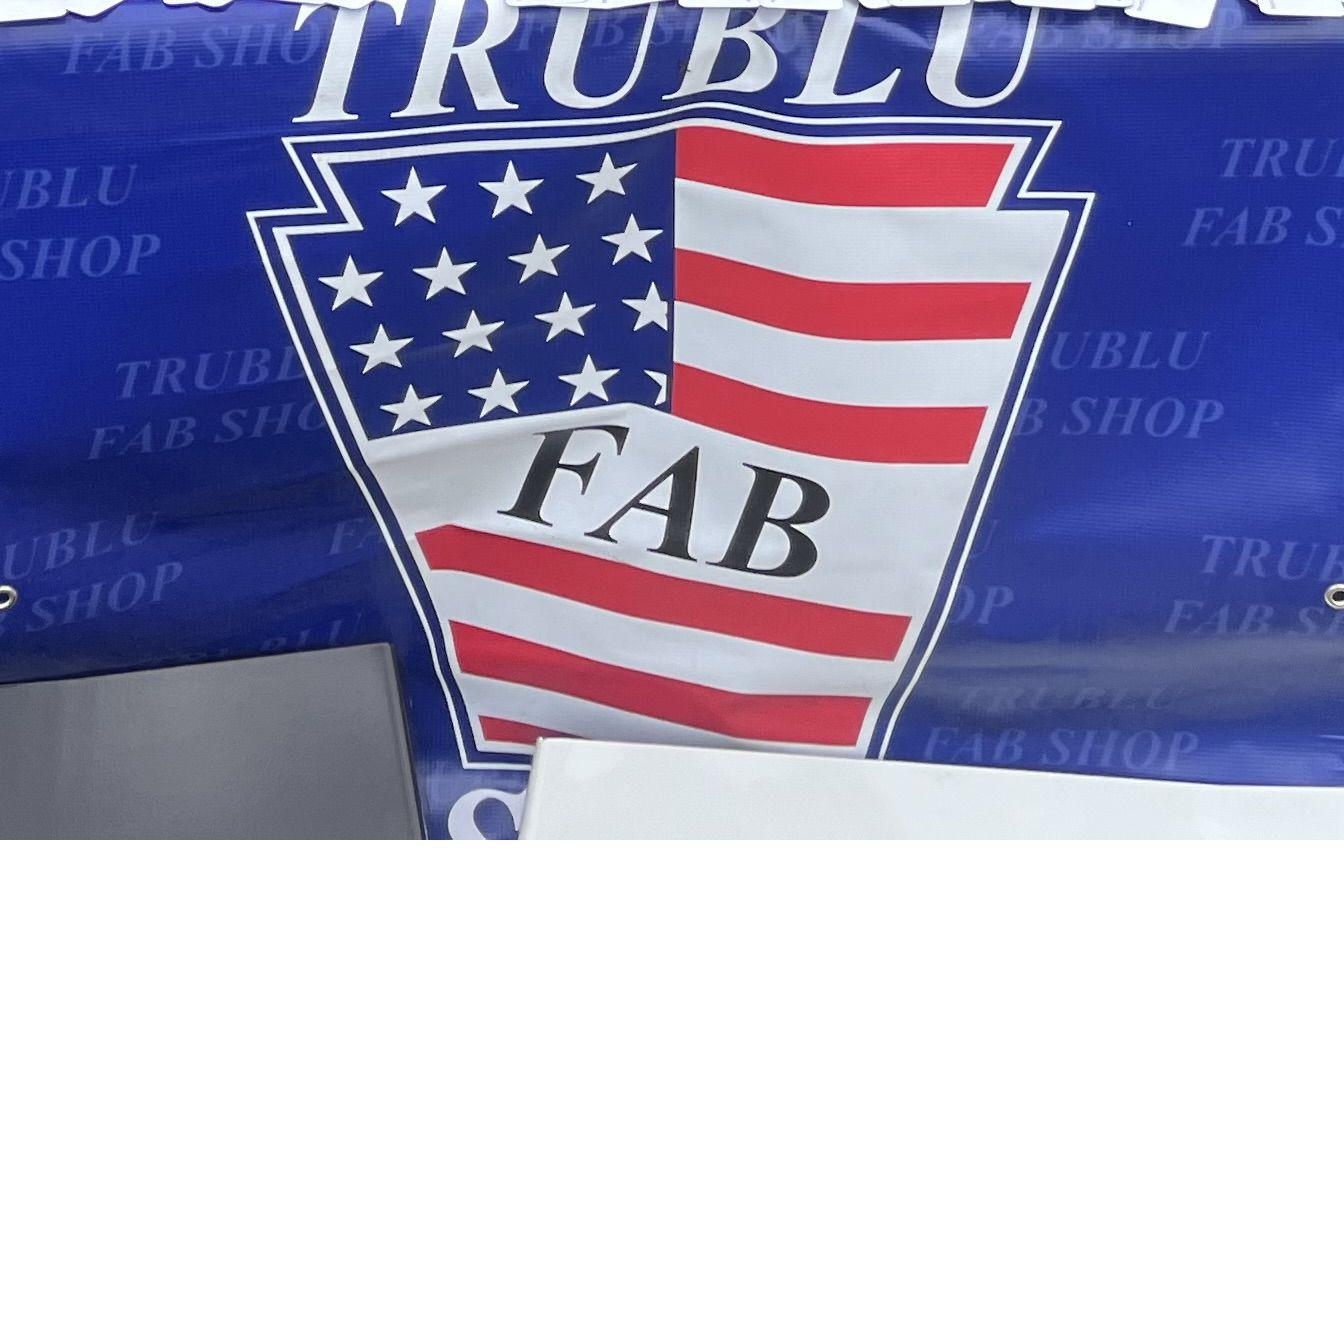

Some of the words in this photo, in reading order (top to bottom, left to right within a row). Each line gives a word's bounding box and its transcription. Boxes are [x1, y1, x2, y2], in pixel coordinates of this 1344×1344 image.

[63, 28, 191, 75] FAB
[202, 18, 324, 68] SHO
[1182, 207, 1289, 247] FAB
[115, 346, 304, 401] TRUBL
[1051, 330, 1212, 371] UBLU
[87, 416, 197, 462] FAB
[208, 398, 328, 447] SHO
[1062, 397, 1226, 441] SHOP
[498, 425, 831, 579] FAB
[26, 561, 185, 632] SHOP
[924, 725, 1026, 764] FAB
[1040, 729, 1200, 770] SHOP
